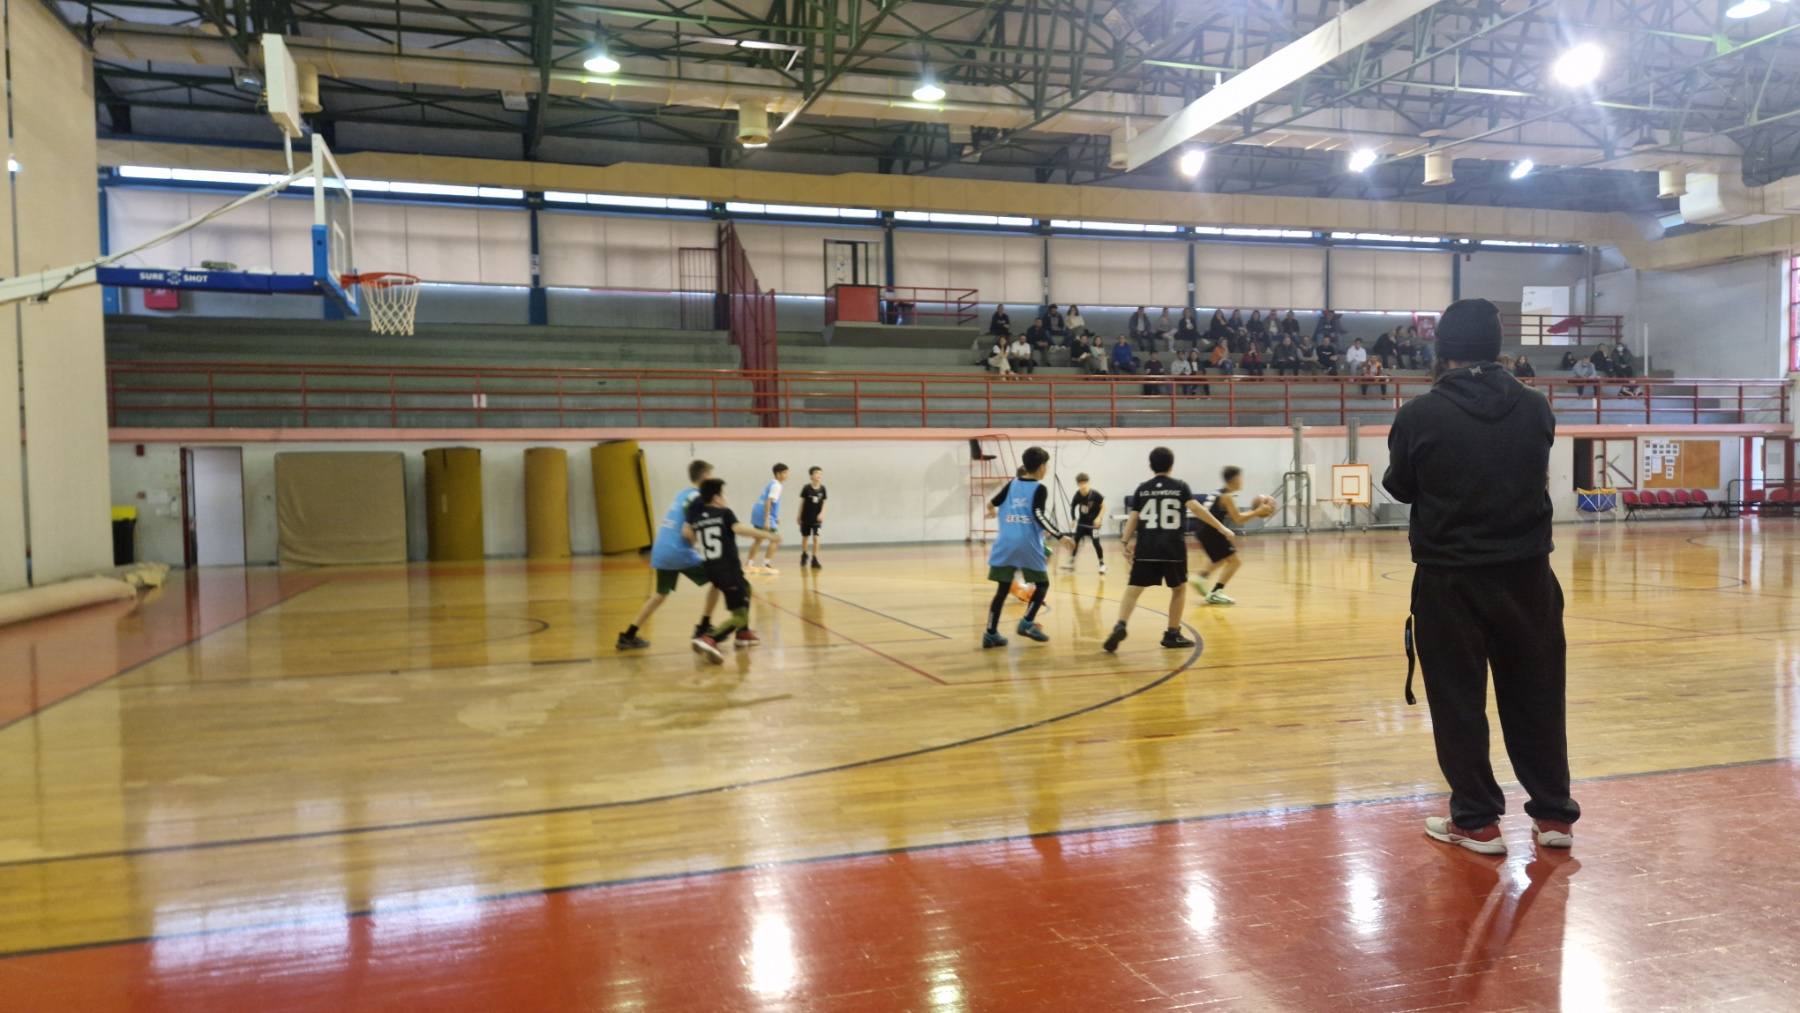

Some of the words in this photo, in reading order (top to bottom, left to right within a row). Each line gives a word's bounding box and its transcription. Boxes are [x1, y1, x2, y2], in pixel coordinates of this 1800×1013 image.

[139, 272, 165, 281] SURE
[183, 274, 208, 283] SHOT
[1139, 498, 1181, 530] 46
